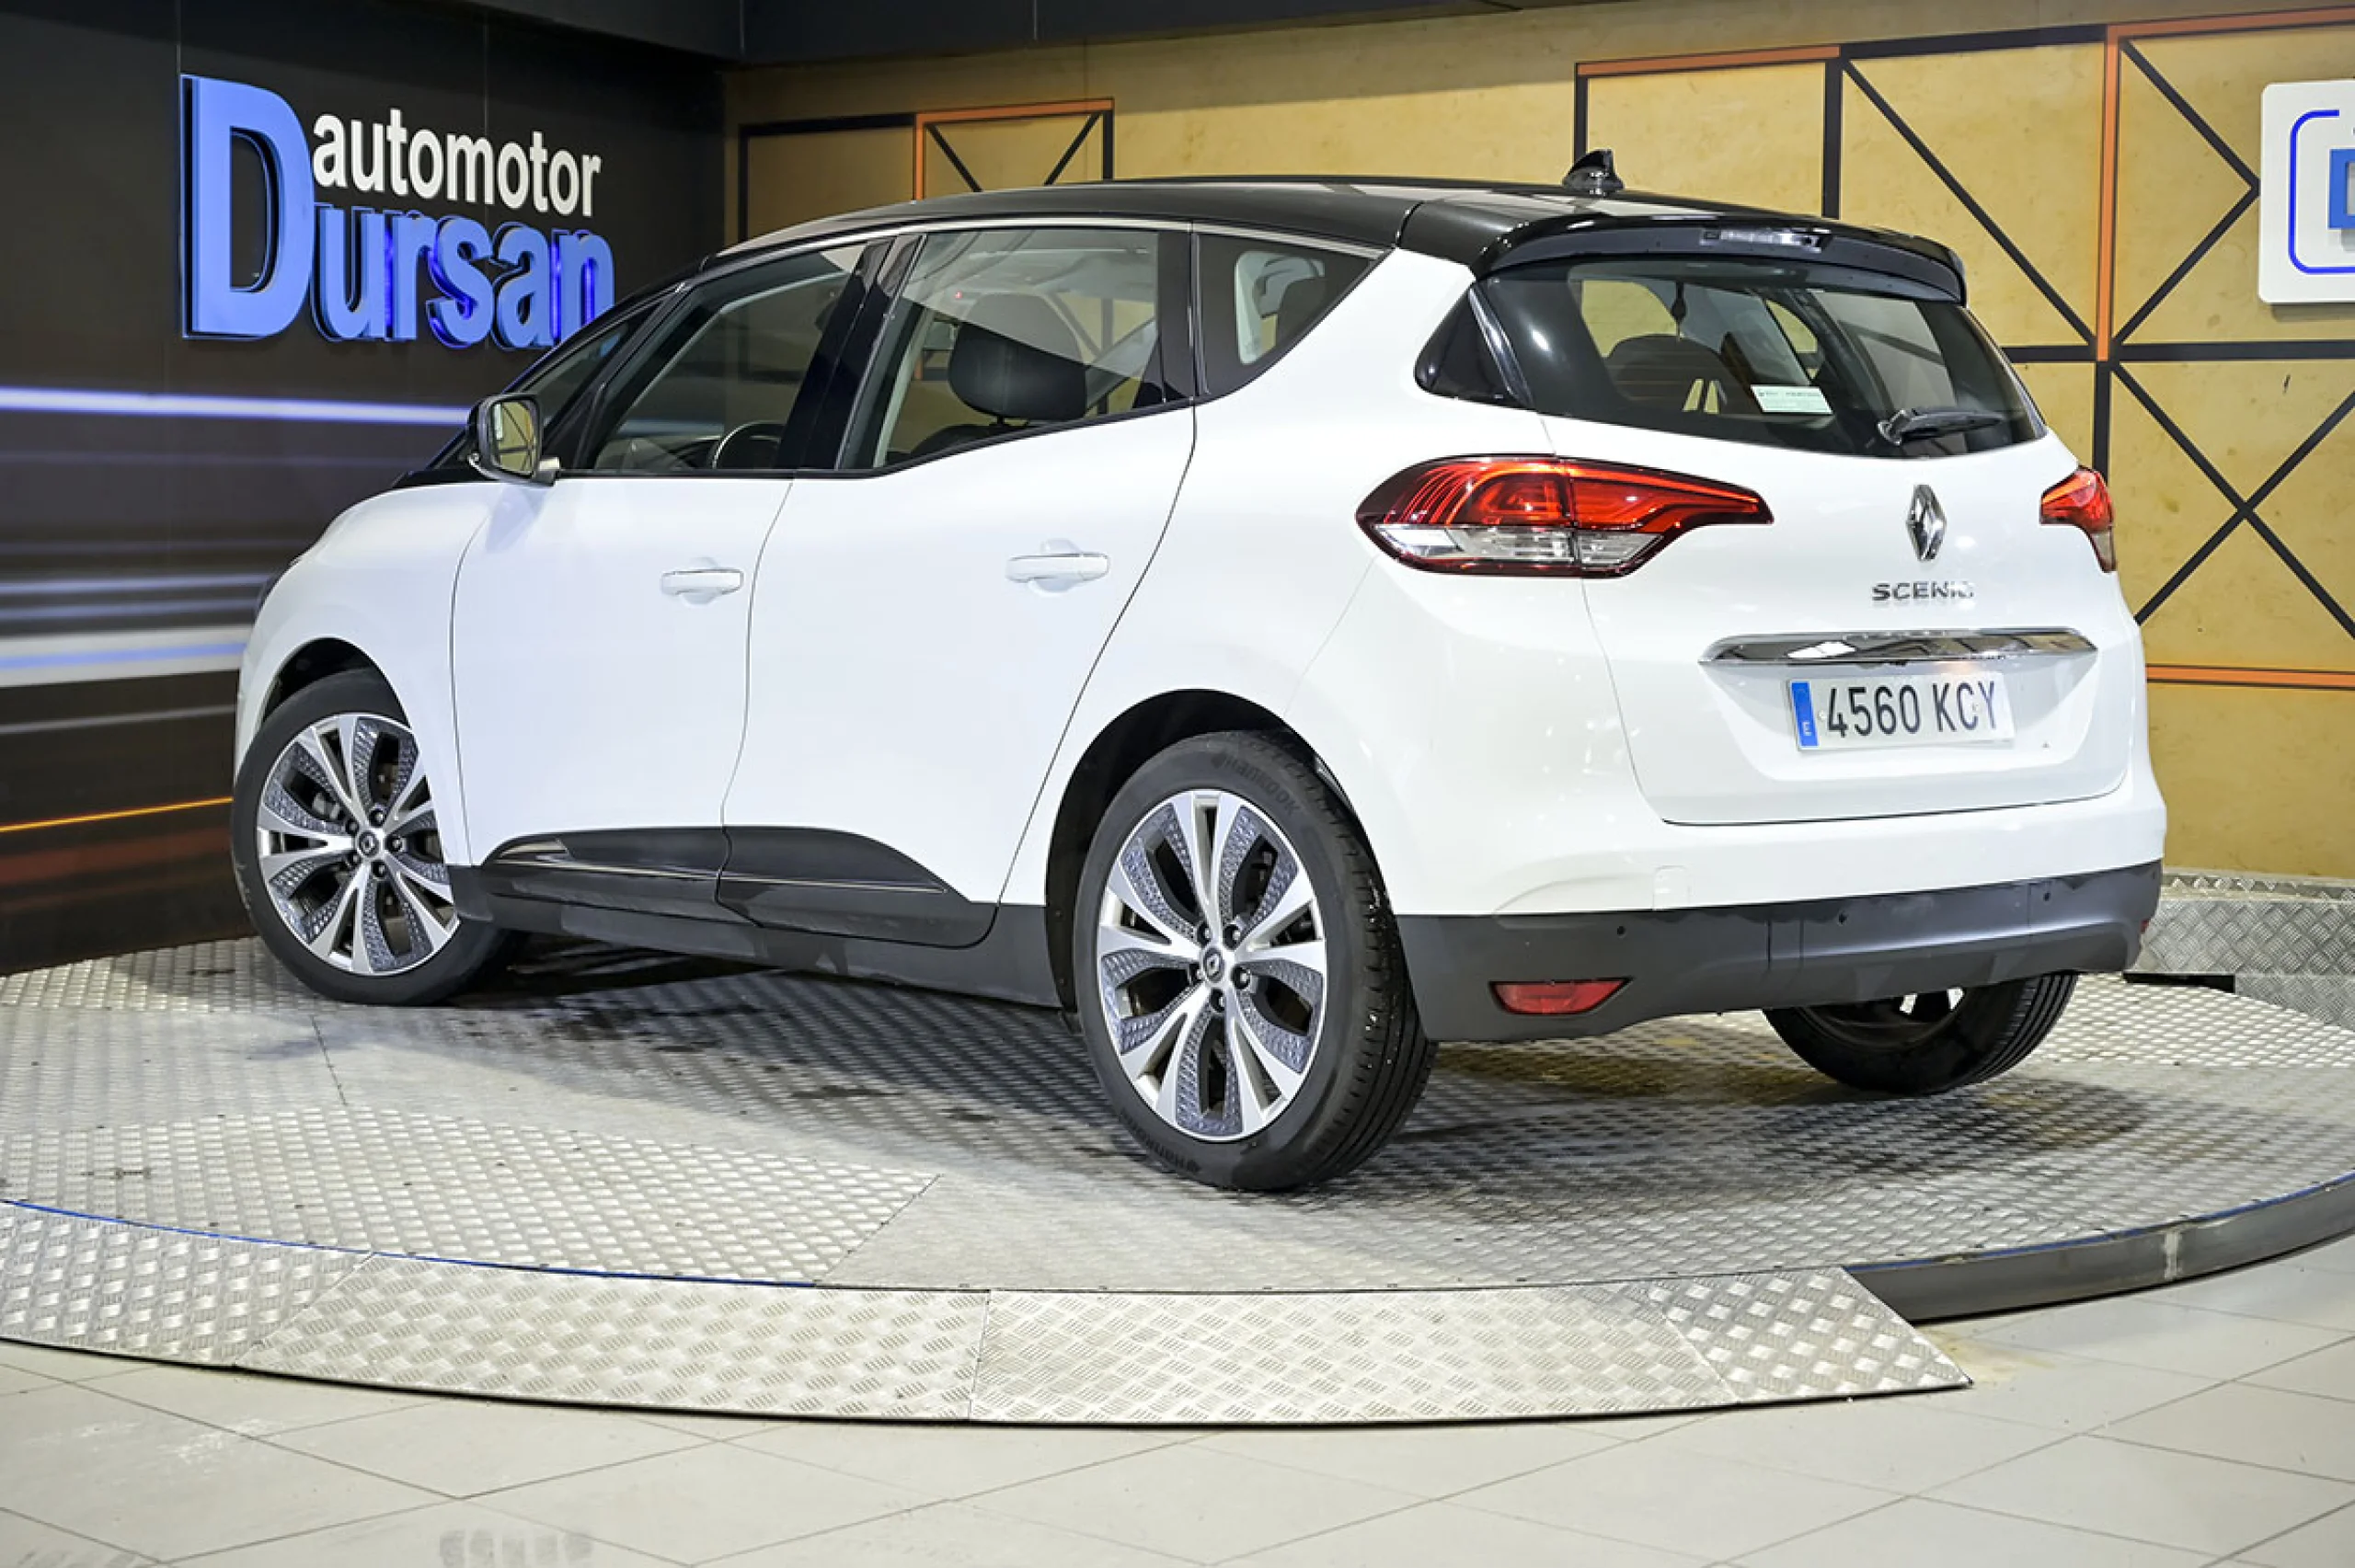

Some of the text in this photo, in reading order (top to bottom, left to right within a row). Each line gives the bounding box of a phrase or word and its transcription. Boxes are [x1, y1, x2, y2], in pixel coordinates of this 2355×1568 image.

[180, 74, 615, 349] Dursan
[314, 108, 601, 216] automotor
[1802, 681, 1996, 738] E 4560 KCY
